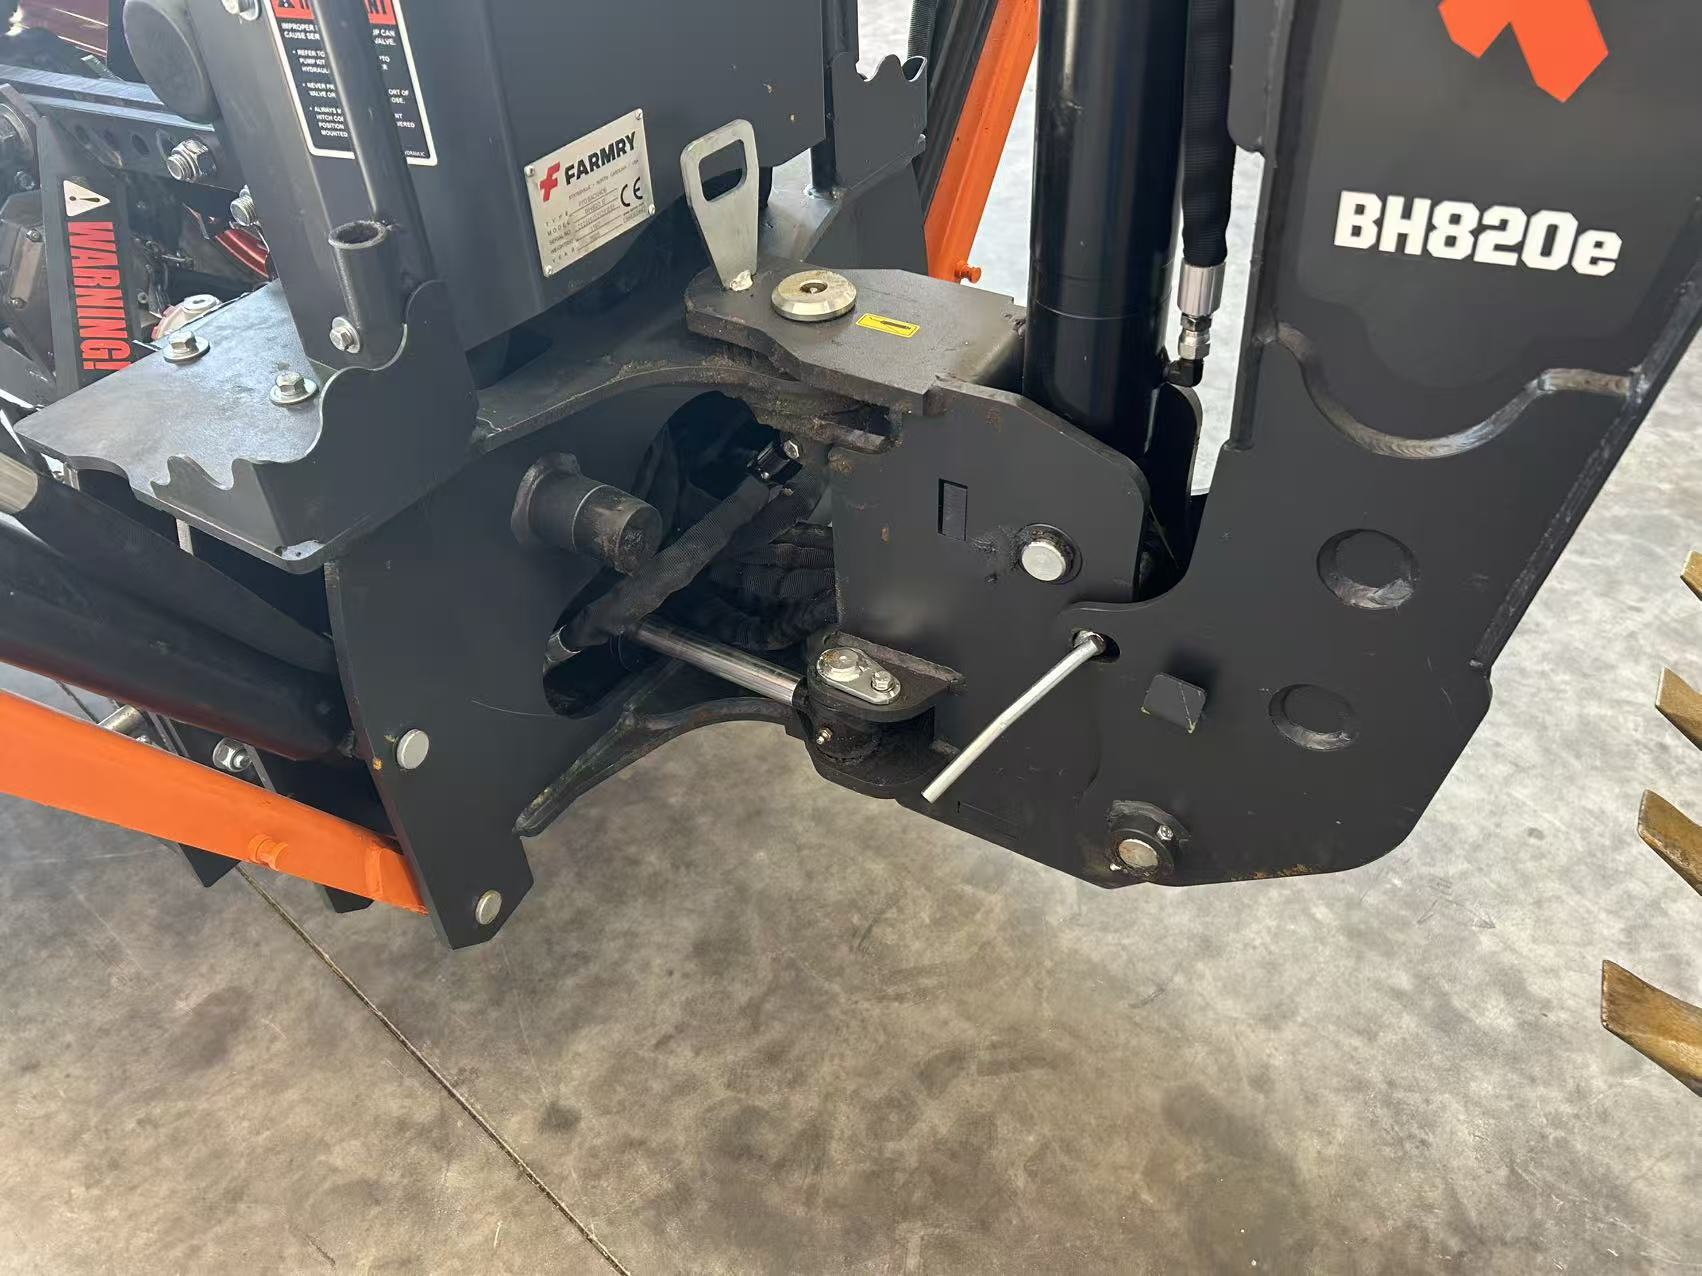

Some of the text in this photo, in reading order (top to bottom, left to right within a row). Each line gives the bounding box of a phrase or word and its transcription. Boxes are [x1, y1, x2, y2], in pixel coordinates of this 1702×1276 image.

[284, 31, 306, 39] CAUSE
[564, 131, 636, 185] FARMRY
[1334, 190, 1623, 277] BH820e
[67, 221, 132, 371] WARNING!
